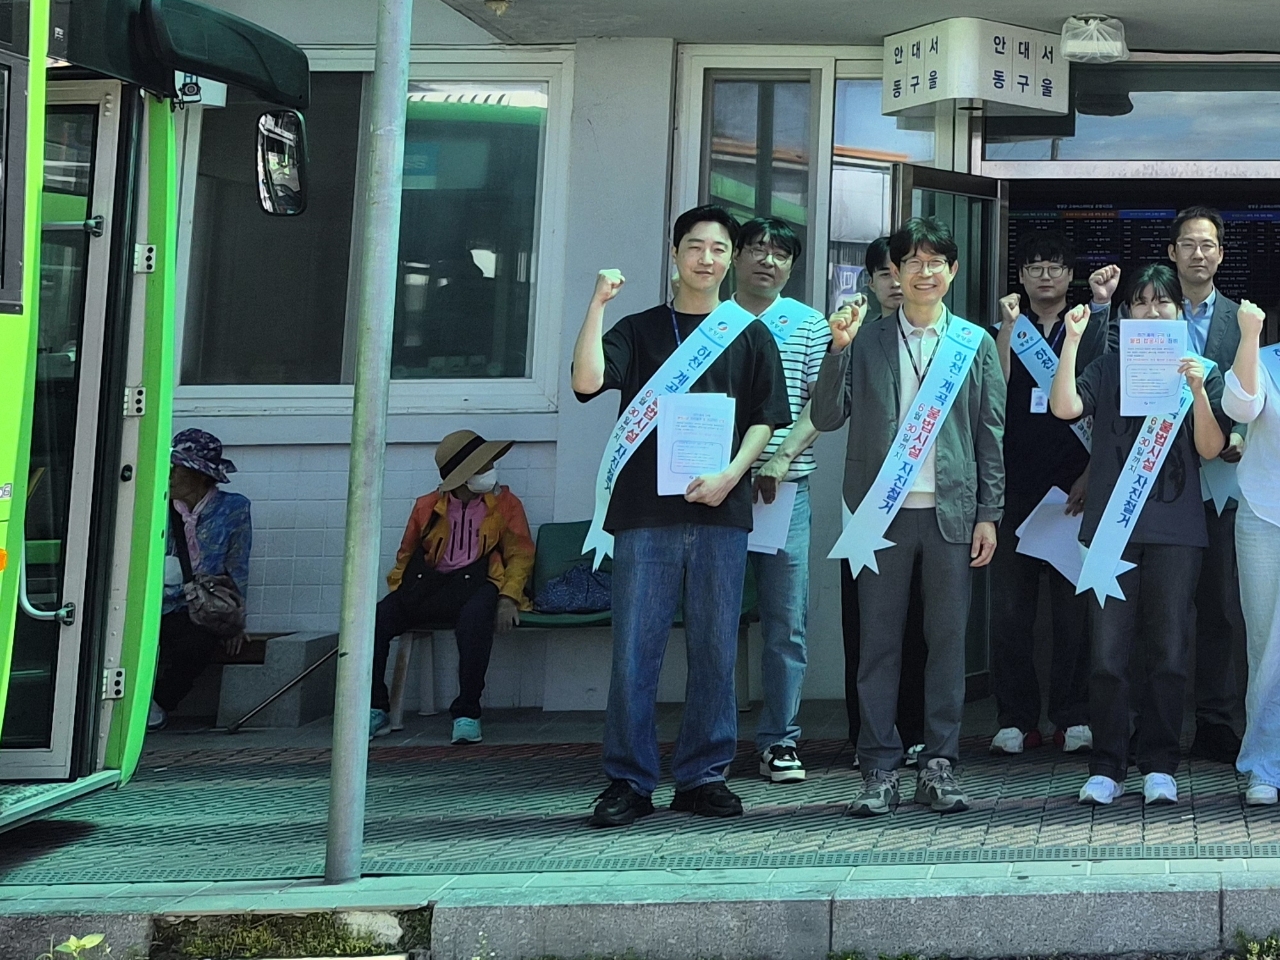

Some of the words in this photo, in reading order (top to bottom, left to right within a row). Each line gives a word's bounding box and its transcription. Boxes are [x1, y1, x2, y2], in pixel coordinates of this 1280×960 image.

[625, 397, 658, 444] 법시설
[908, 405, 941, 460] 불법시설
[1142, 419, 1174, 472] 불법시설
[878, 461, 914, 514] 자진철거
[1117, 474, 1148, 528] 자진철거
